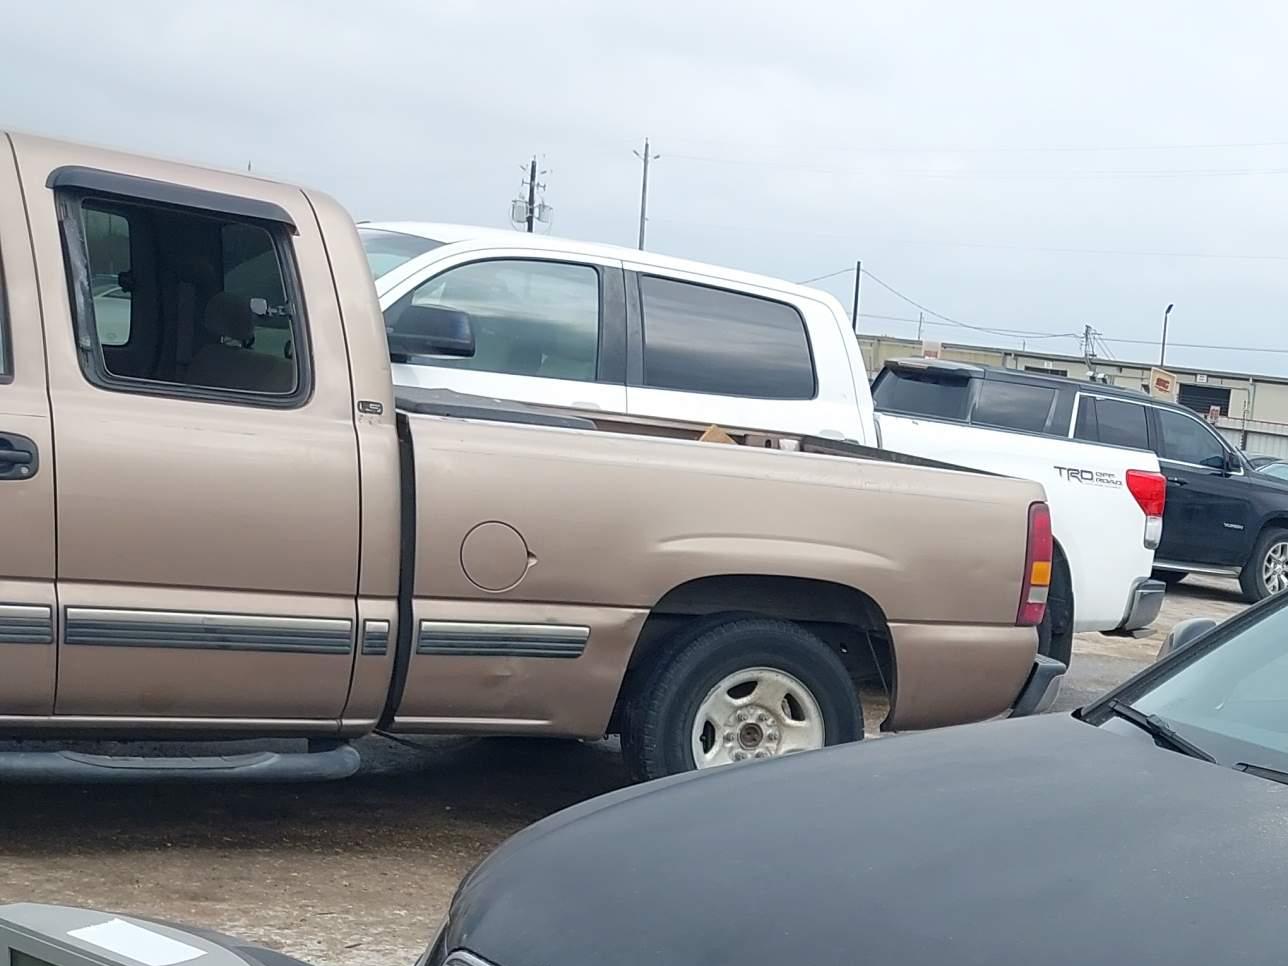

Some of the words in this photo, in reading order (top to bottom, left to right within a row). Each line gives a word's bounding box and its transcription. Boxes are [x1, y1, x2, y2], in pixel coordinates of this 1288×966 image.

[359, 402, 381, 413] LS
[1053, 466, 1094, 483] TRD
[1095, 478, 1122, 486] ROAD
